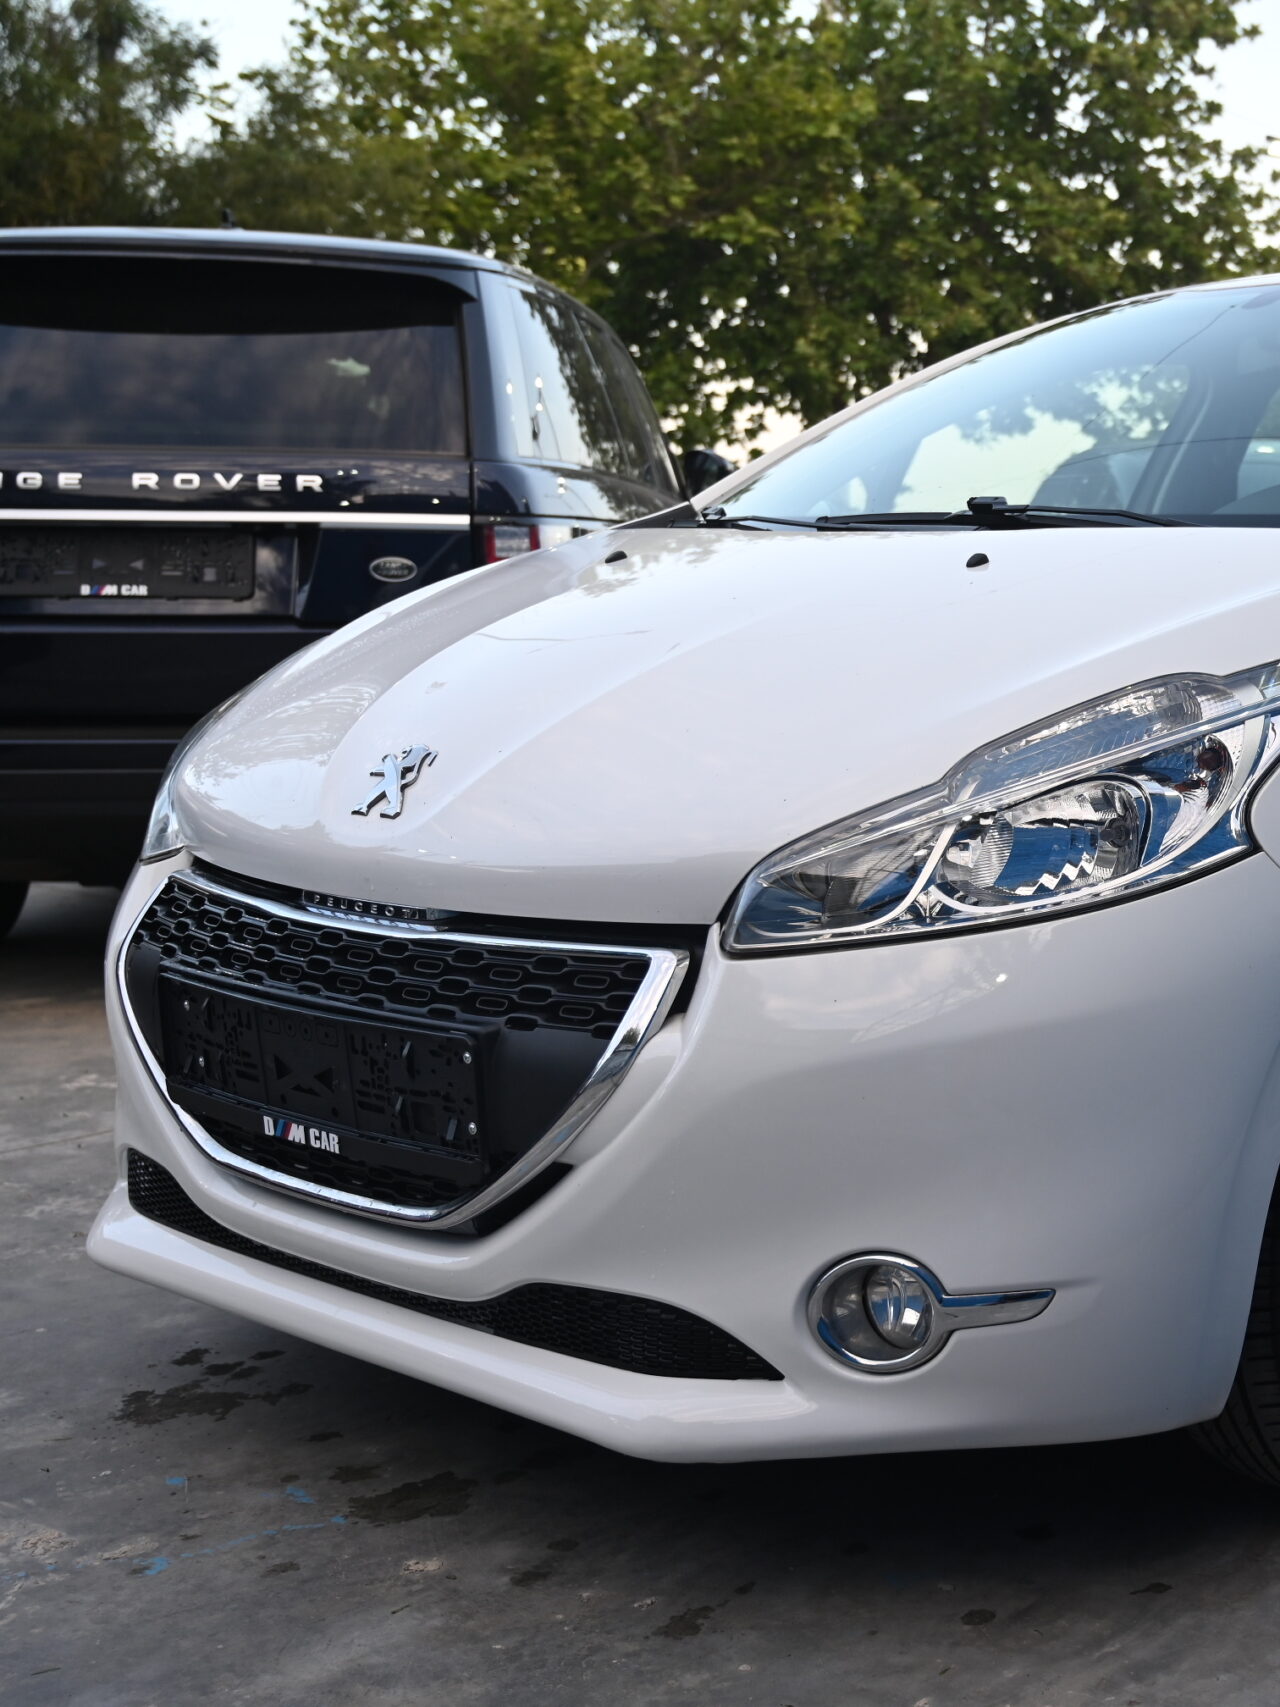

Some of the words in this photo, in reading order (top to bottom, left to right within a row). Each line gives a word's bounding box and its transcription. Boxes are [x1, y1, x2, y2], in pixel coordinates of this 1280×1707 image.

[0, 471, 83, 489] GE
[132, 472, 323, 492] ROVER
[120, 583, 148, 596] CAR
[313, 894, 412, 918] PEUGEOT
[309, 1128, 340, 1154] CAR
